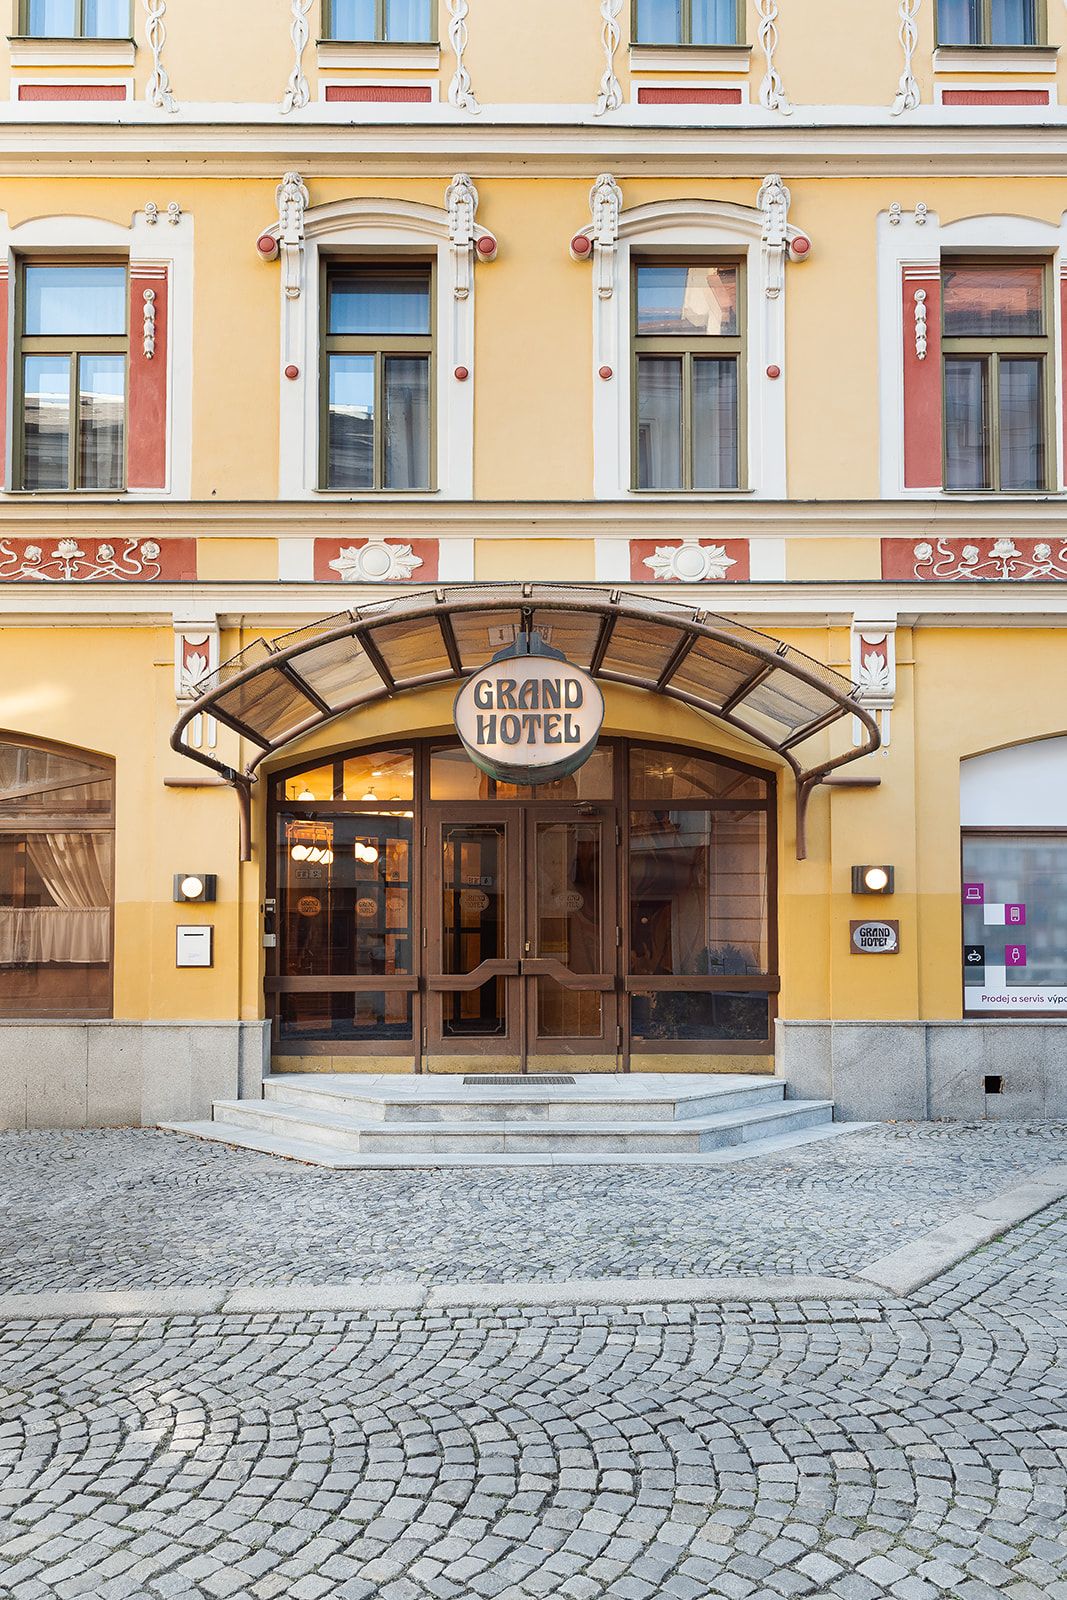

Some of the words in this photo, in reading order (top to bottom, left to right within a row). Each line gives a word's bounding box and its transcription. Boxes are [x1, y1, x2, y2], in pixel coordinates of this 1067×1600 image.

[474, 678, 583, 710] GRAND
[476, 713, 581, 745] HOTEL
[860, 927, 890, 938] GRAND
[981, 994, 1009, 1004] Prodej
[1019, 994, 1044, 1003] servis
